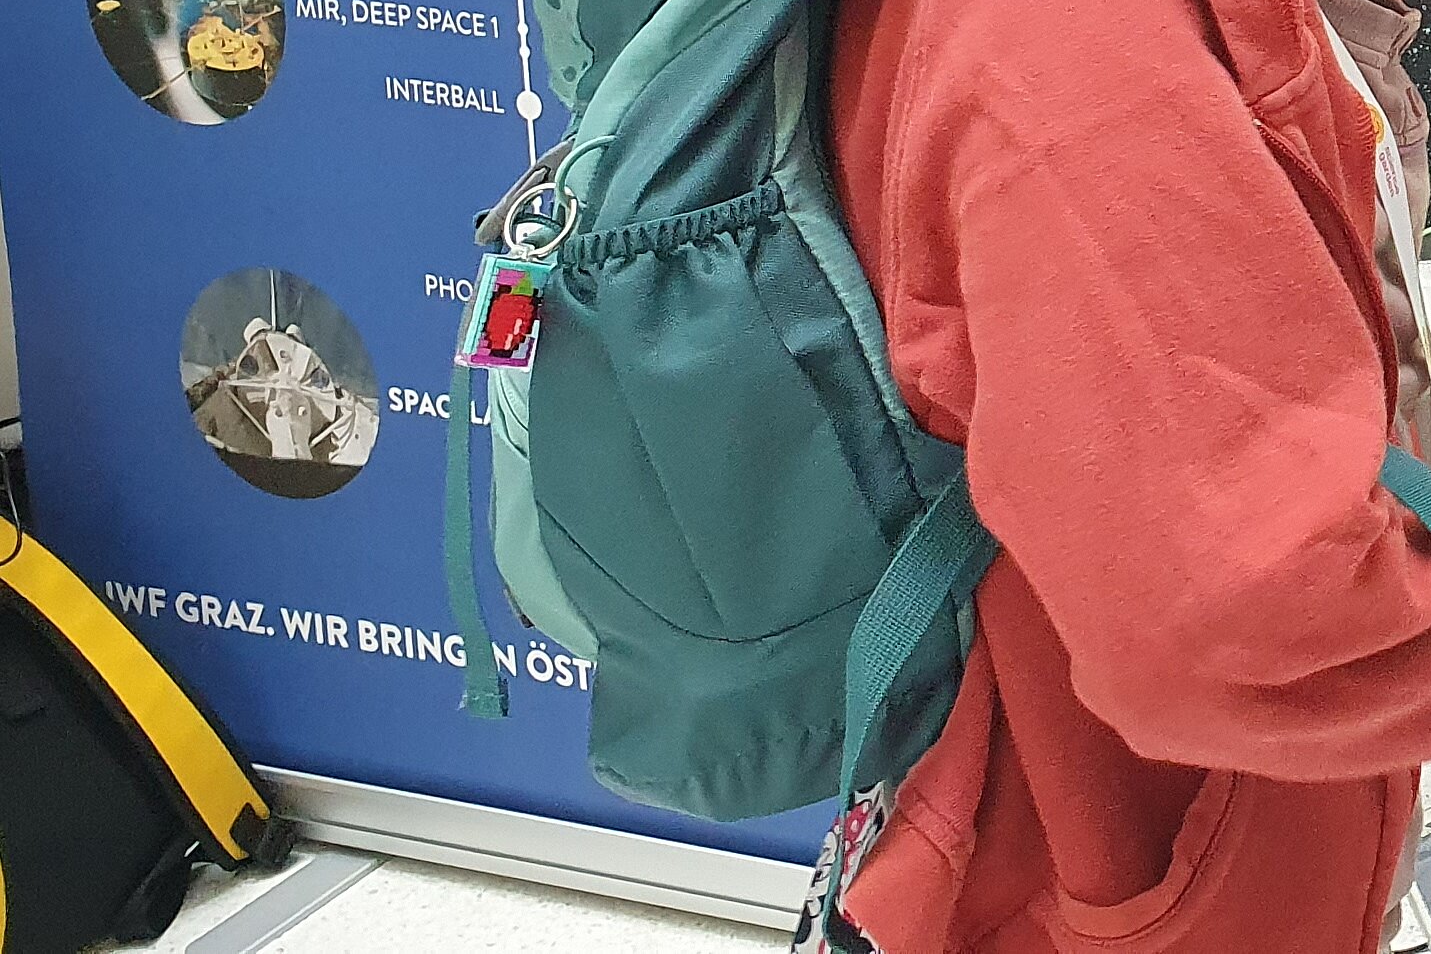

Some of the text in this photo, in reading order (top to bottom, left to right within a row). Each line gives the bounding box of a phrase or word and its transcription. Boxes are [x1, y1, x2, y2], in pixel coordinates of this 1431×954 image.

[351, 0, 412, 27] DEEP
[415, 6, 487, 37] SPACE
[490, 16, 499, 39] 1
[385, 76, 505, 114] INTERBALL
[175, 592, 275, 637] GRAZ.
[280, 607, 349, 649] WIR
[358, 620, 516, 677] BRINGN
[526, 640, 597, 691] ÖST
